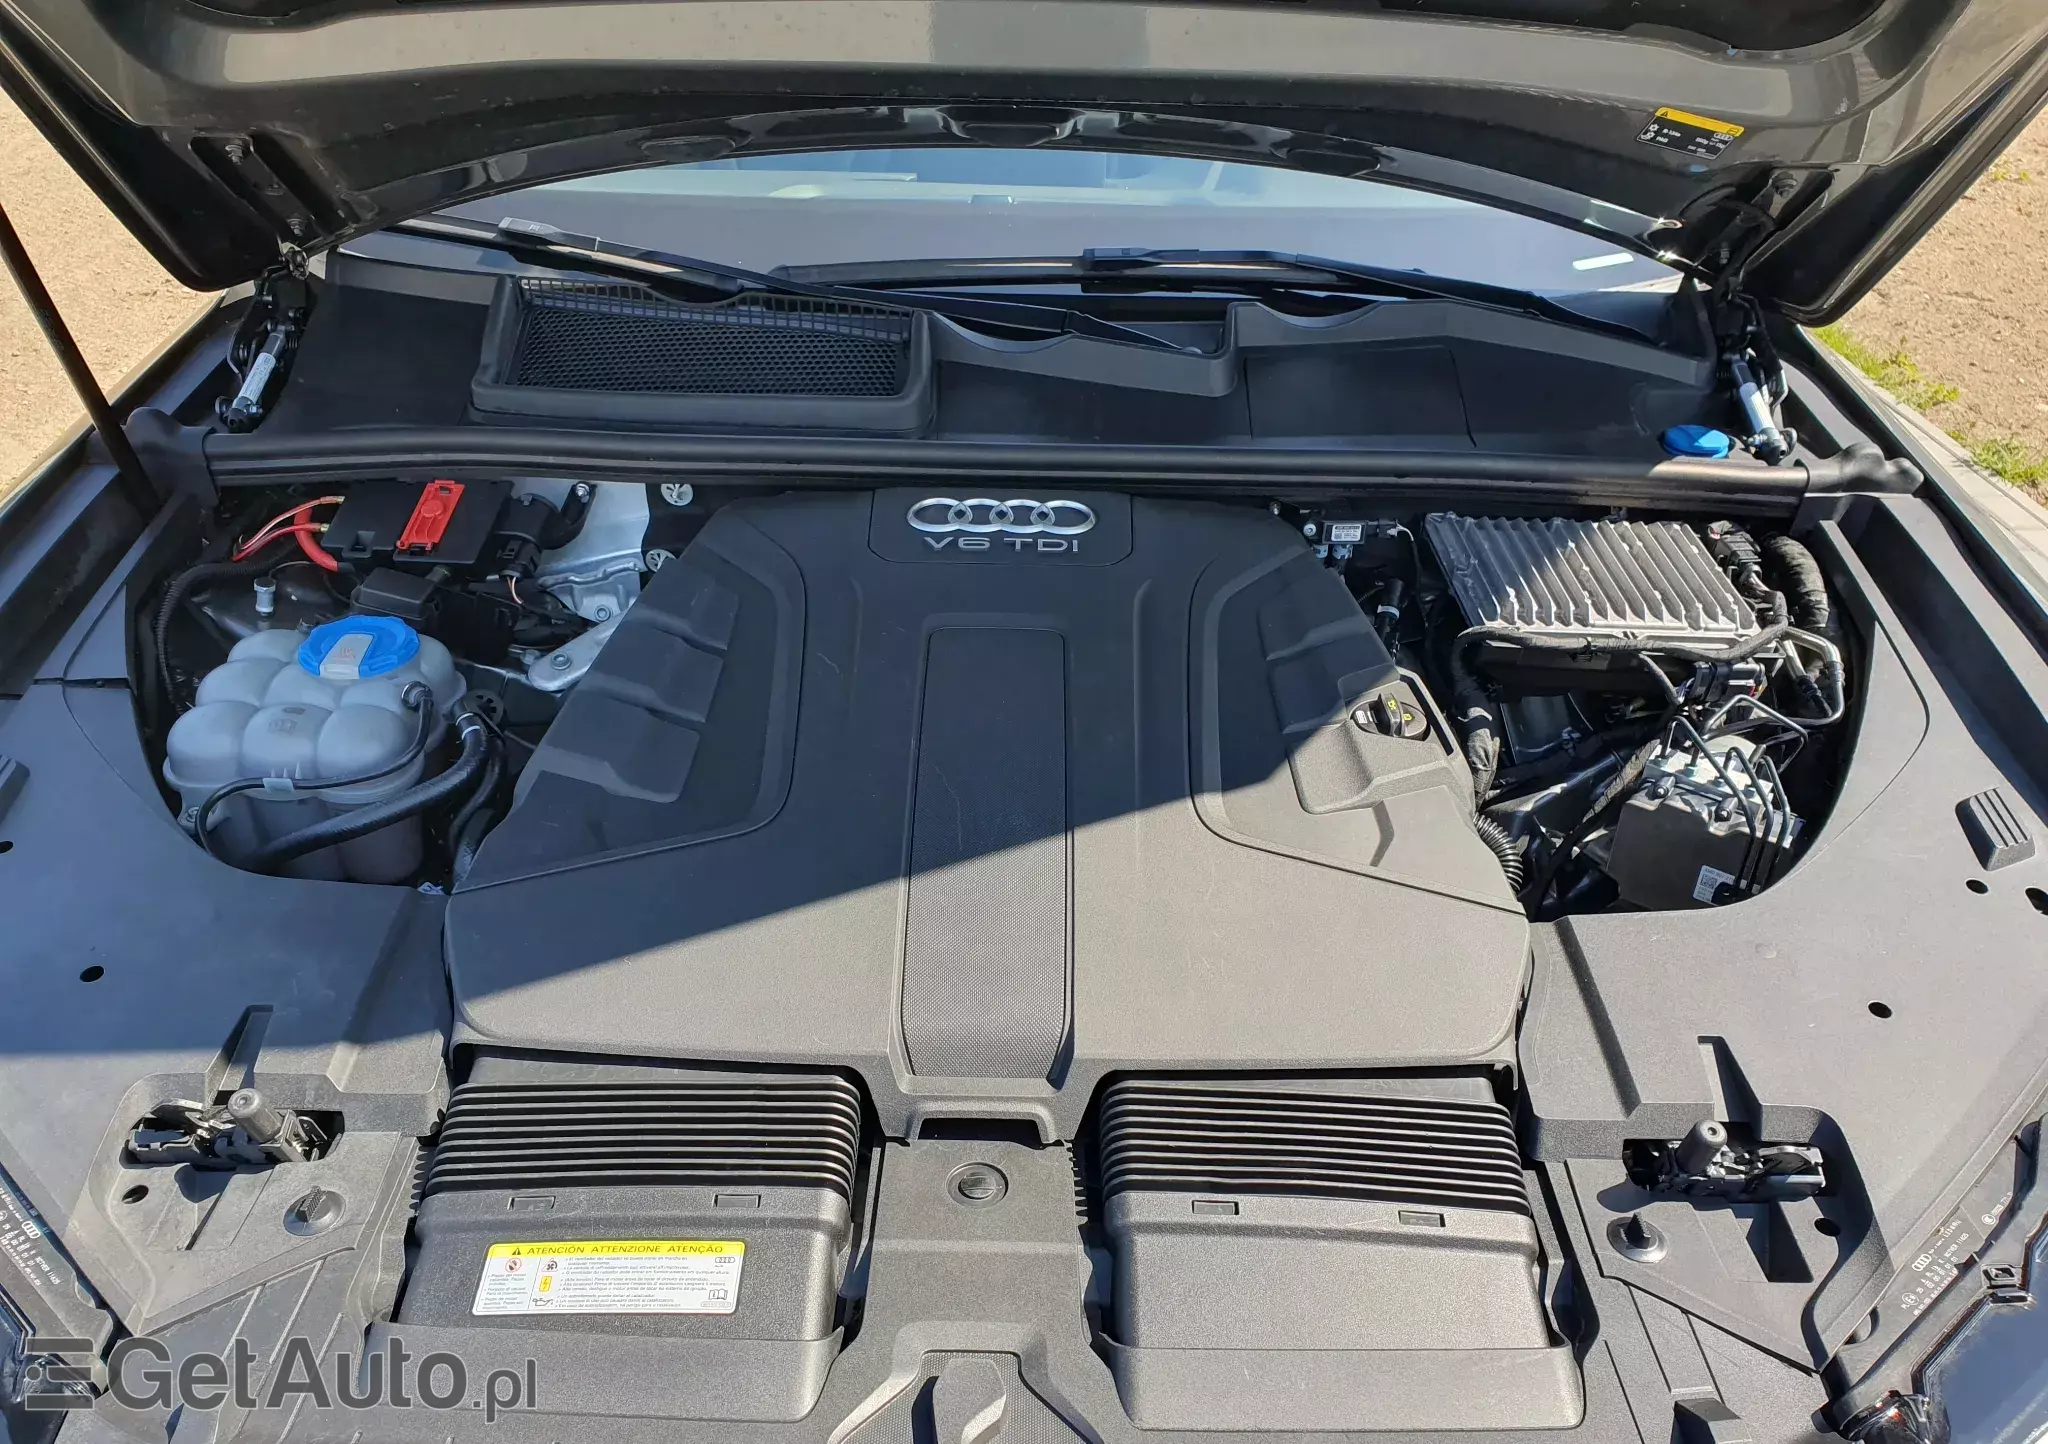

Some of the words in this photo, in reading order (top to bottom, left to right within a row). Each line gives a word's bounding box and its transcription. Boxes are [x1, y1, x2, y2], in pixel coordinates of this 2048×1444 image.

[924, 536, 991, 550] V6
[1004, 537, 1079, 552] TDI
[527, 1245, 585, 1255] ATENCIÓN
[591, 1245, 661, 1254] ATTENZIONE
[667, 1245, 723, 1254] ATENÇÃO
